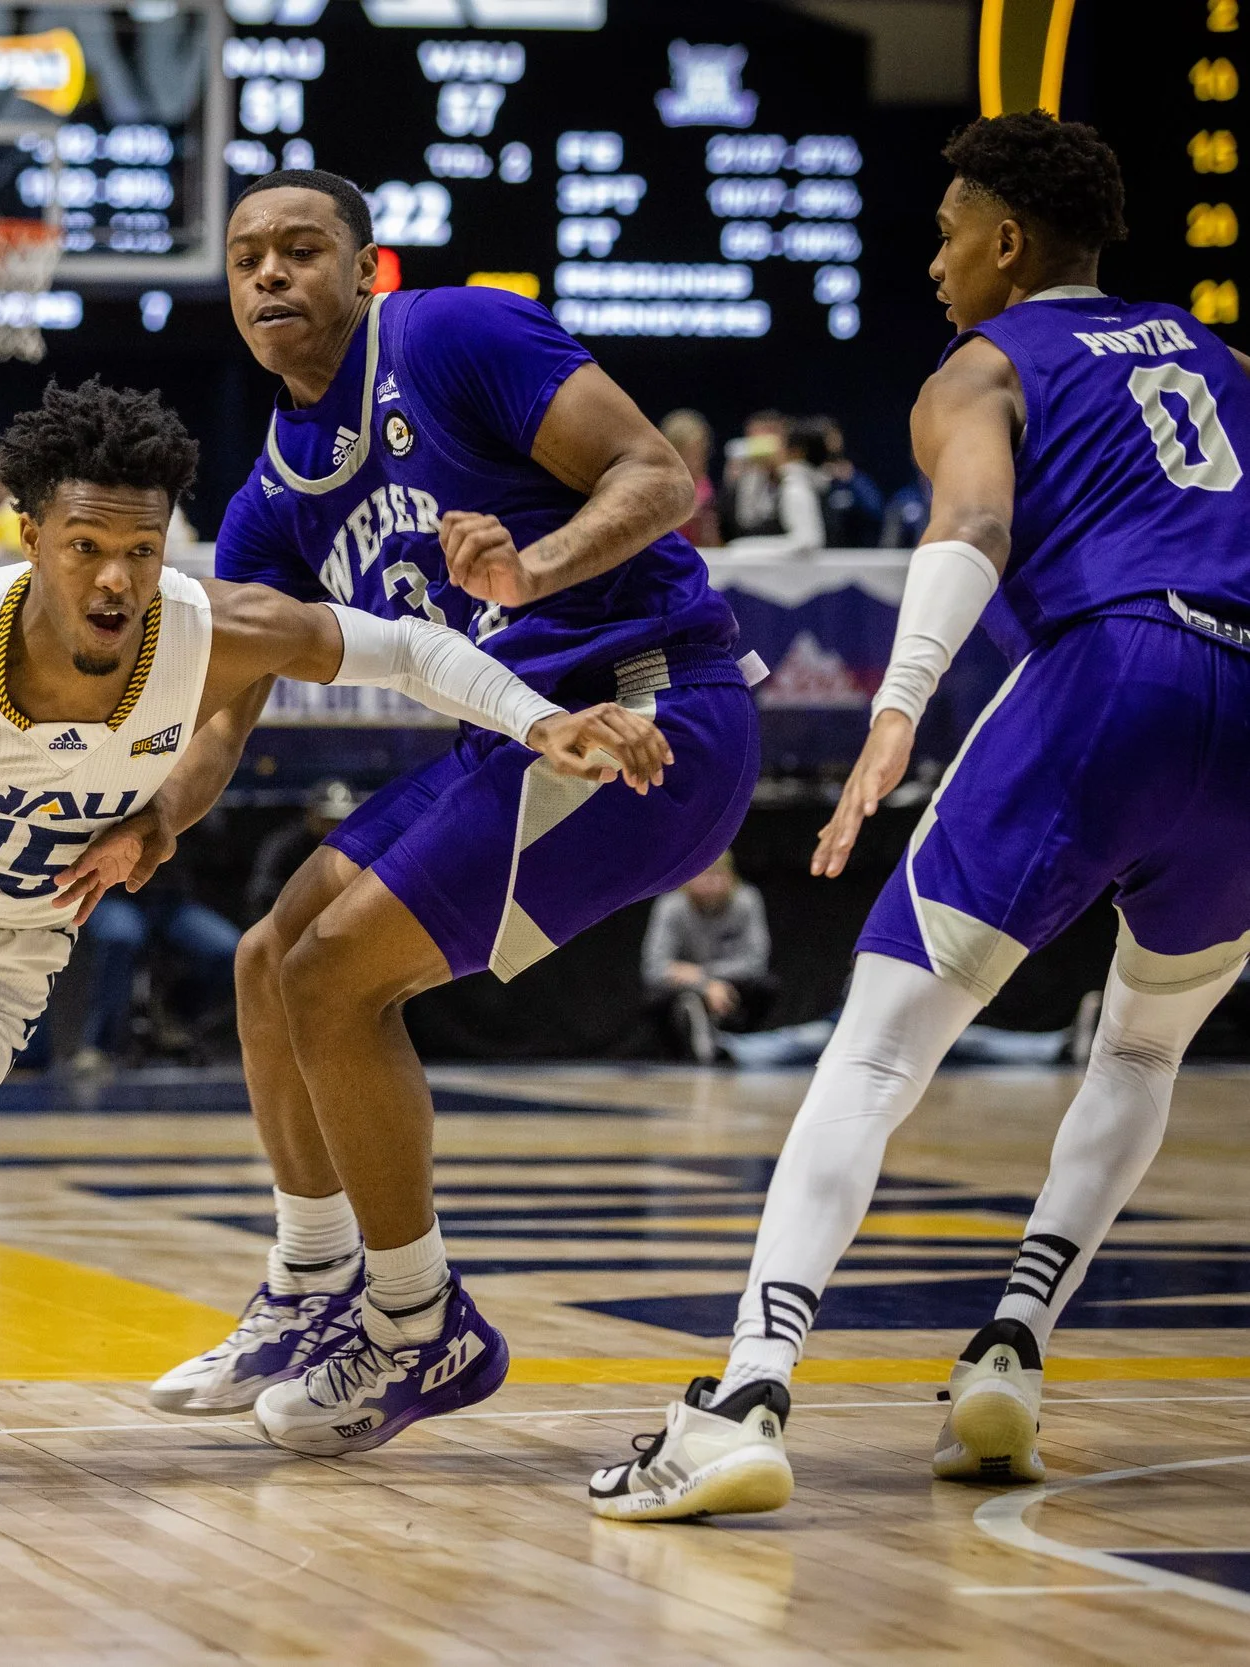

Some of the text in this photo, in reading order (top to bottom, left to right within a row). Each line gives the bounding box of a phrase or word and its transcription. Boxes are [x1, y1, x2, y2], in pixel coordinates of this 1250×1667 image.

[1072, 319, 1198, 357] PORTER
[1127, 362, 1243, 492] 0
[318, 483, 443, 605] WEBER
[49, 741, 88, 751] adidas
[339, 1421, 370, 1437] WSU
